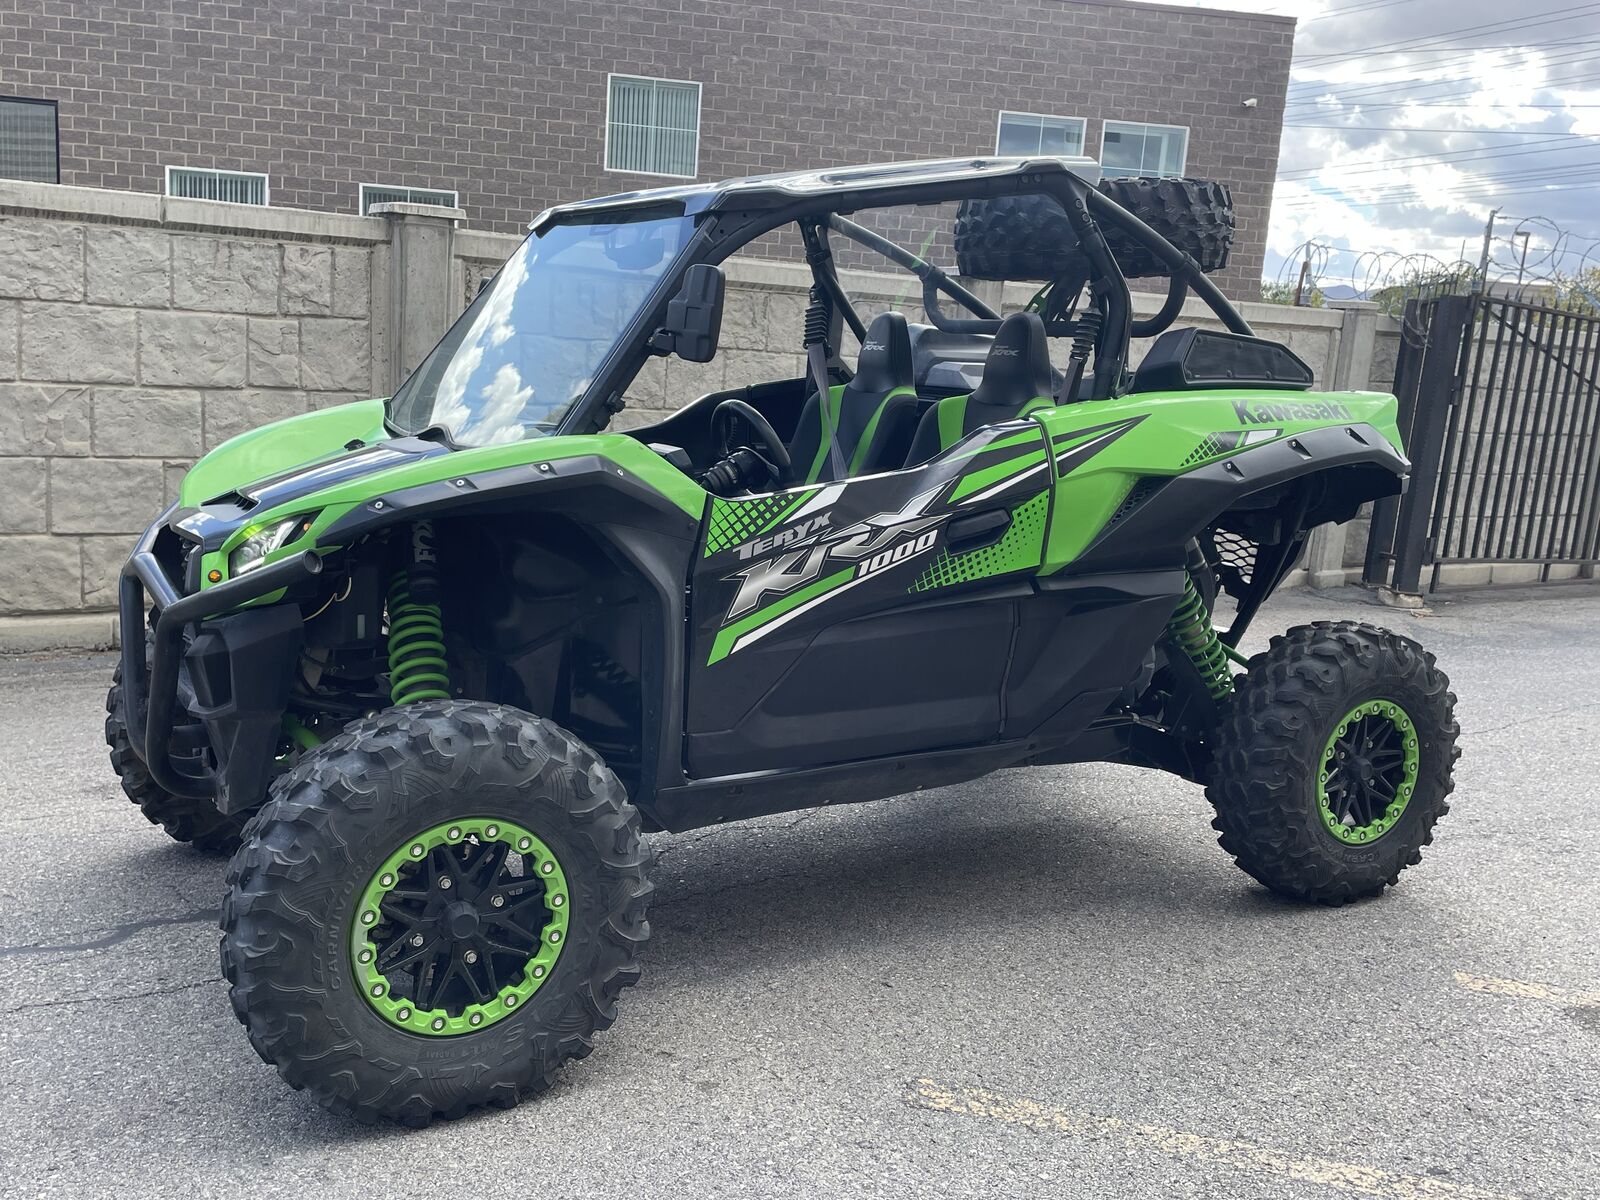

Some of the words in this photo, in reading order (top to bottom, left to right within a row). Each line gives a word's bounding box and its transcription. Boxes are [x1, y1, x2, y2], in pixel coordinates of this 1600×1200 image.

[1231, 400, 1353, 425] Kawasaki
[720, 475, 956, 627] KRX
[858, 529, 938, 577] 1000
[733, 511, 832, 560] TERYX
